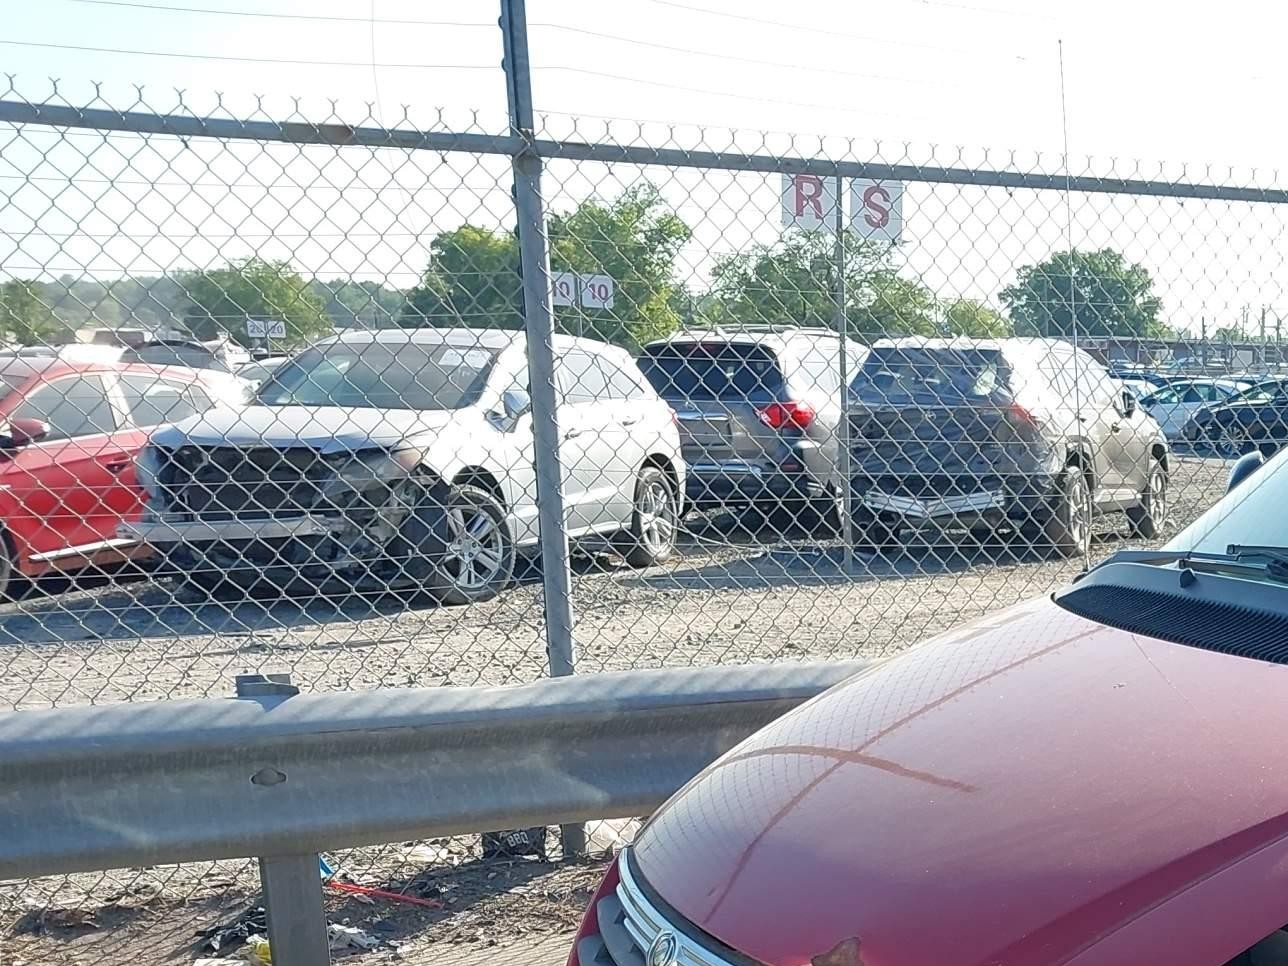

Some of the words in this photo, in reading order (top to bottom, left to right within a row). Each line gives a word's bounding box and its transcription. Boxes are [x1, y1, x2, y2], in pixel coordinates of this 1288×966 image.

[795, 174, 823, 220] R
[863, 185, 891, 228] S
[588, 283, 609, 300] 10
